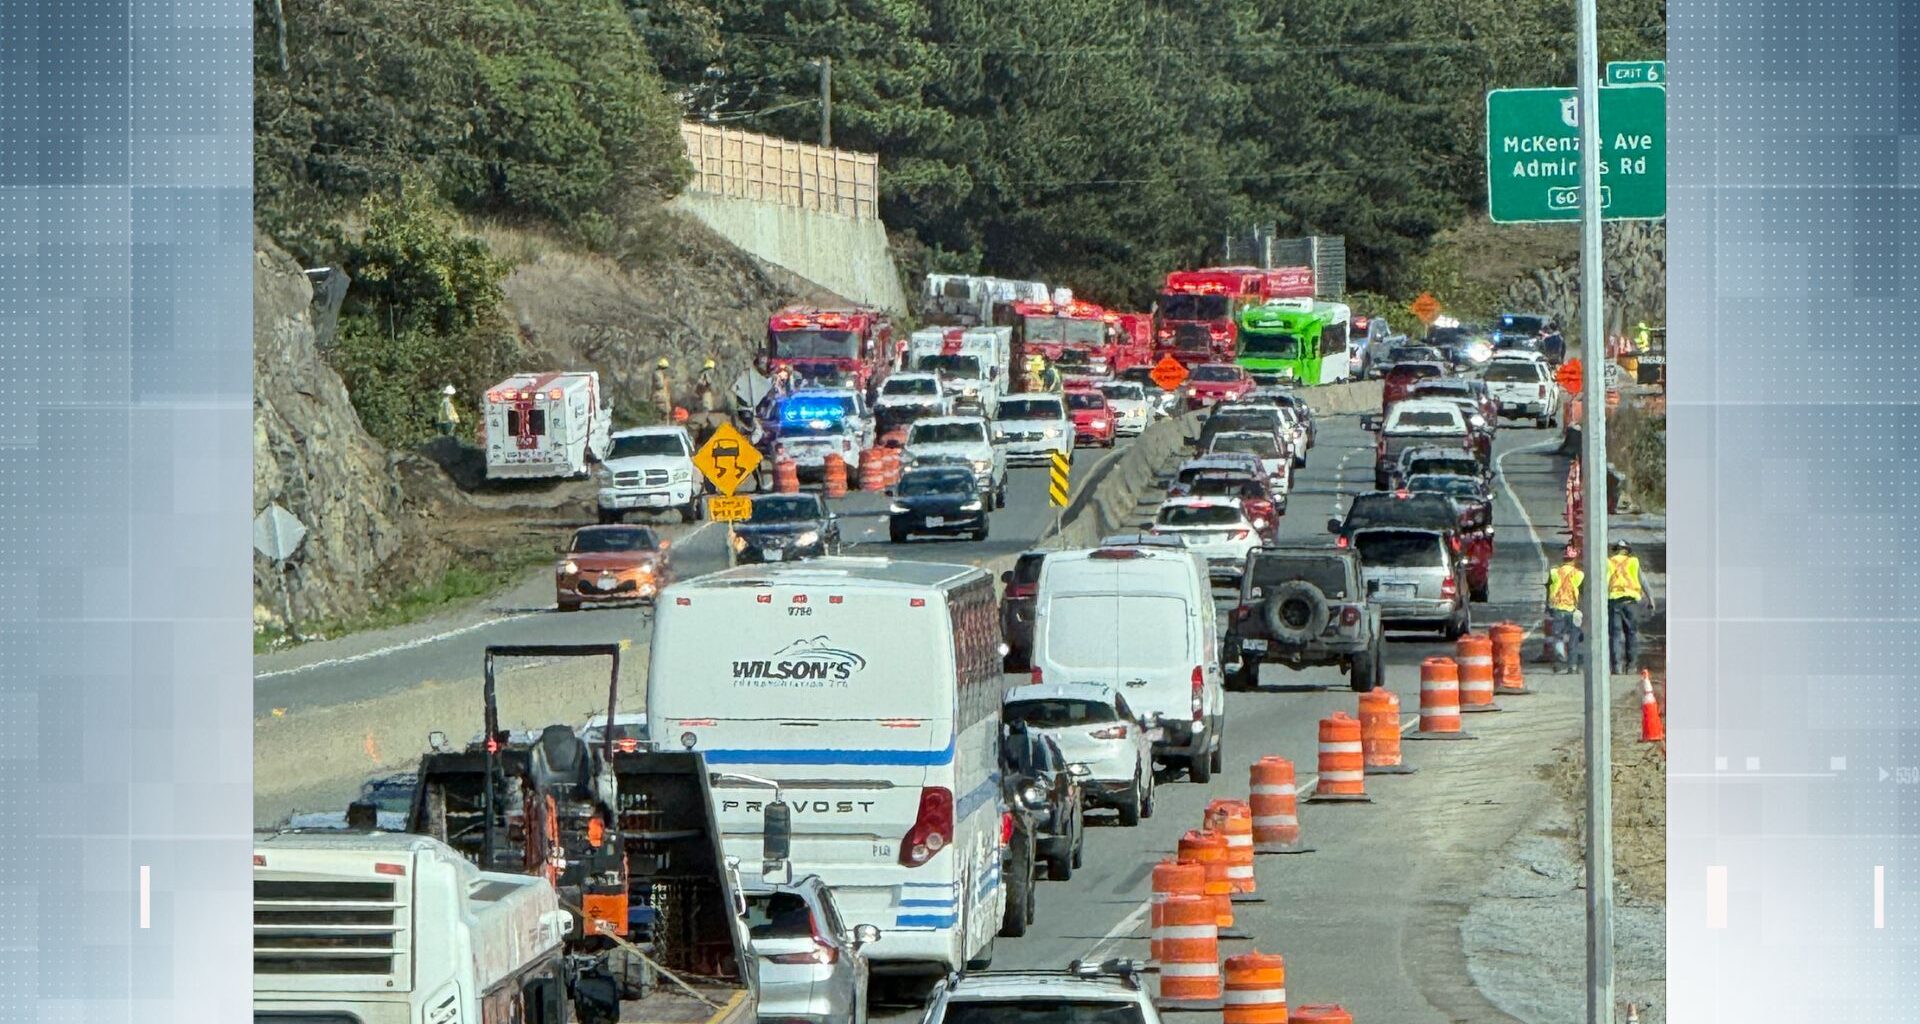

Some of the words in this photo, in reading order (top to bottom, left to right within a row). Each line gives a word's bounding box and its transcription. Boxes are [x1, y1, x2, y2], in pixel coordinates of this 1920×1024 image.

[1615, 68, 1642, 79] EXIT
[1647, 66, 1659, 81] 6
[1503, 134, 1603, 153] McKenz
[1614, 132, 1652, 150] Ave
[1512, 157, 1610, 177] Admirs
[1620, 156, 1646, 175] Rd
[732, 660, 854, 680] WILSON'S
[722, 800, 875, 813] PRVOST
